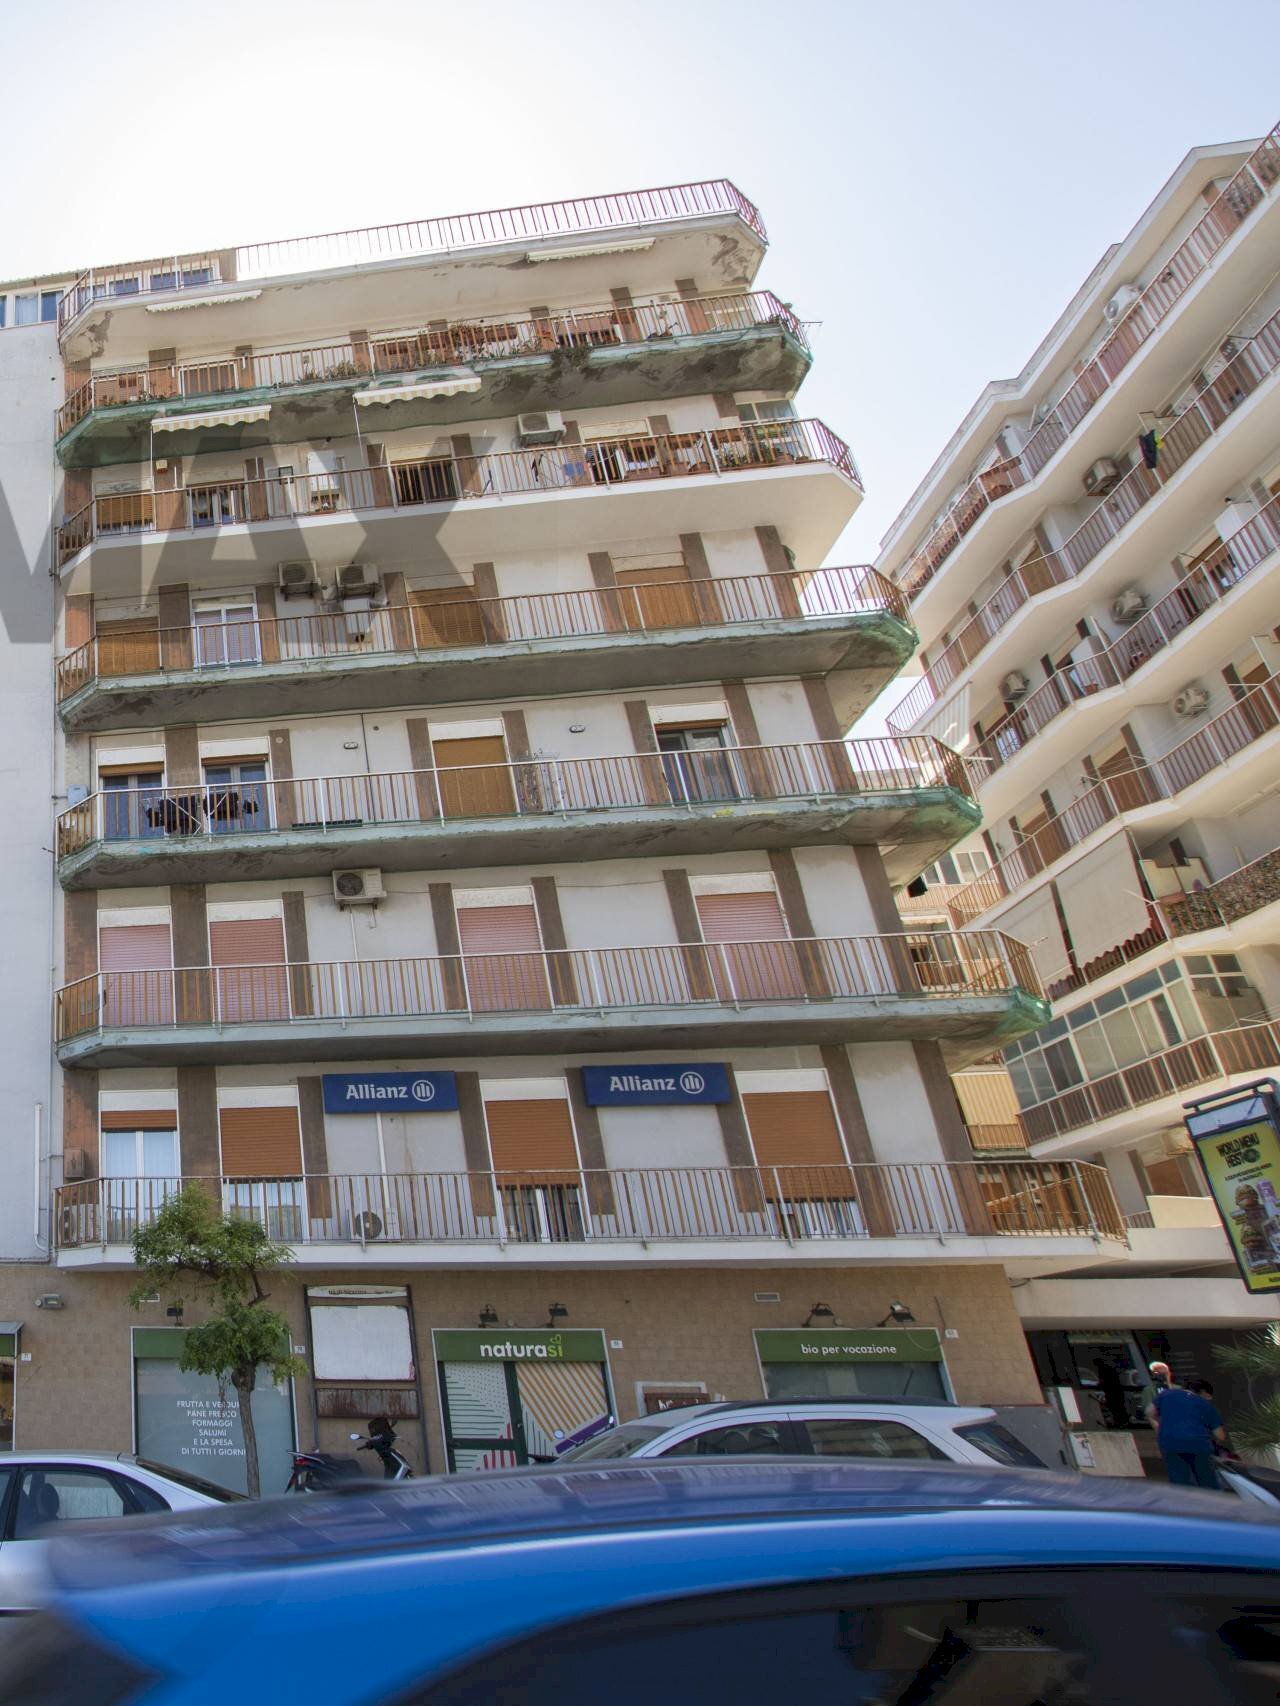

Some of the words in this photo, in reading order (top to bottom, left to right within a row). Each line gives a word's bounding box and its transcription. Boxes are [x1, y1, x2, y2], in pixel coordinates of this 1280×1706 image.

[609, 1074, 676, 1092] Allianz
[345, 1082, 408, 1101] Allianz
[801, 1343, 818, 1354] bio
[822, 1347, 839, 1356] per
[842, 1344, 897, 1354] vocazione
[177, 1400, 203, 1408] FRUTTA
[187, 1410, 206, 1418] PANE
